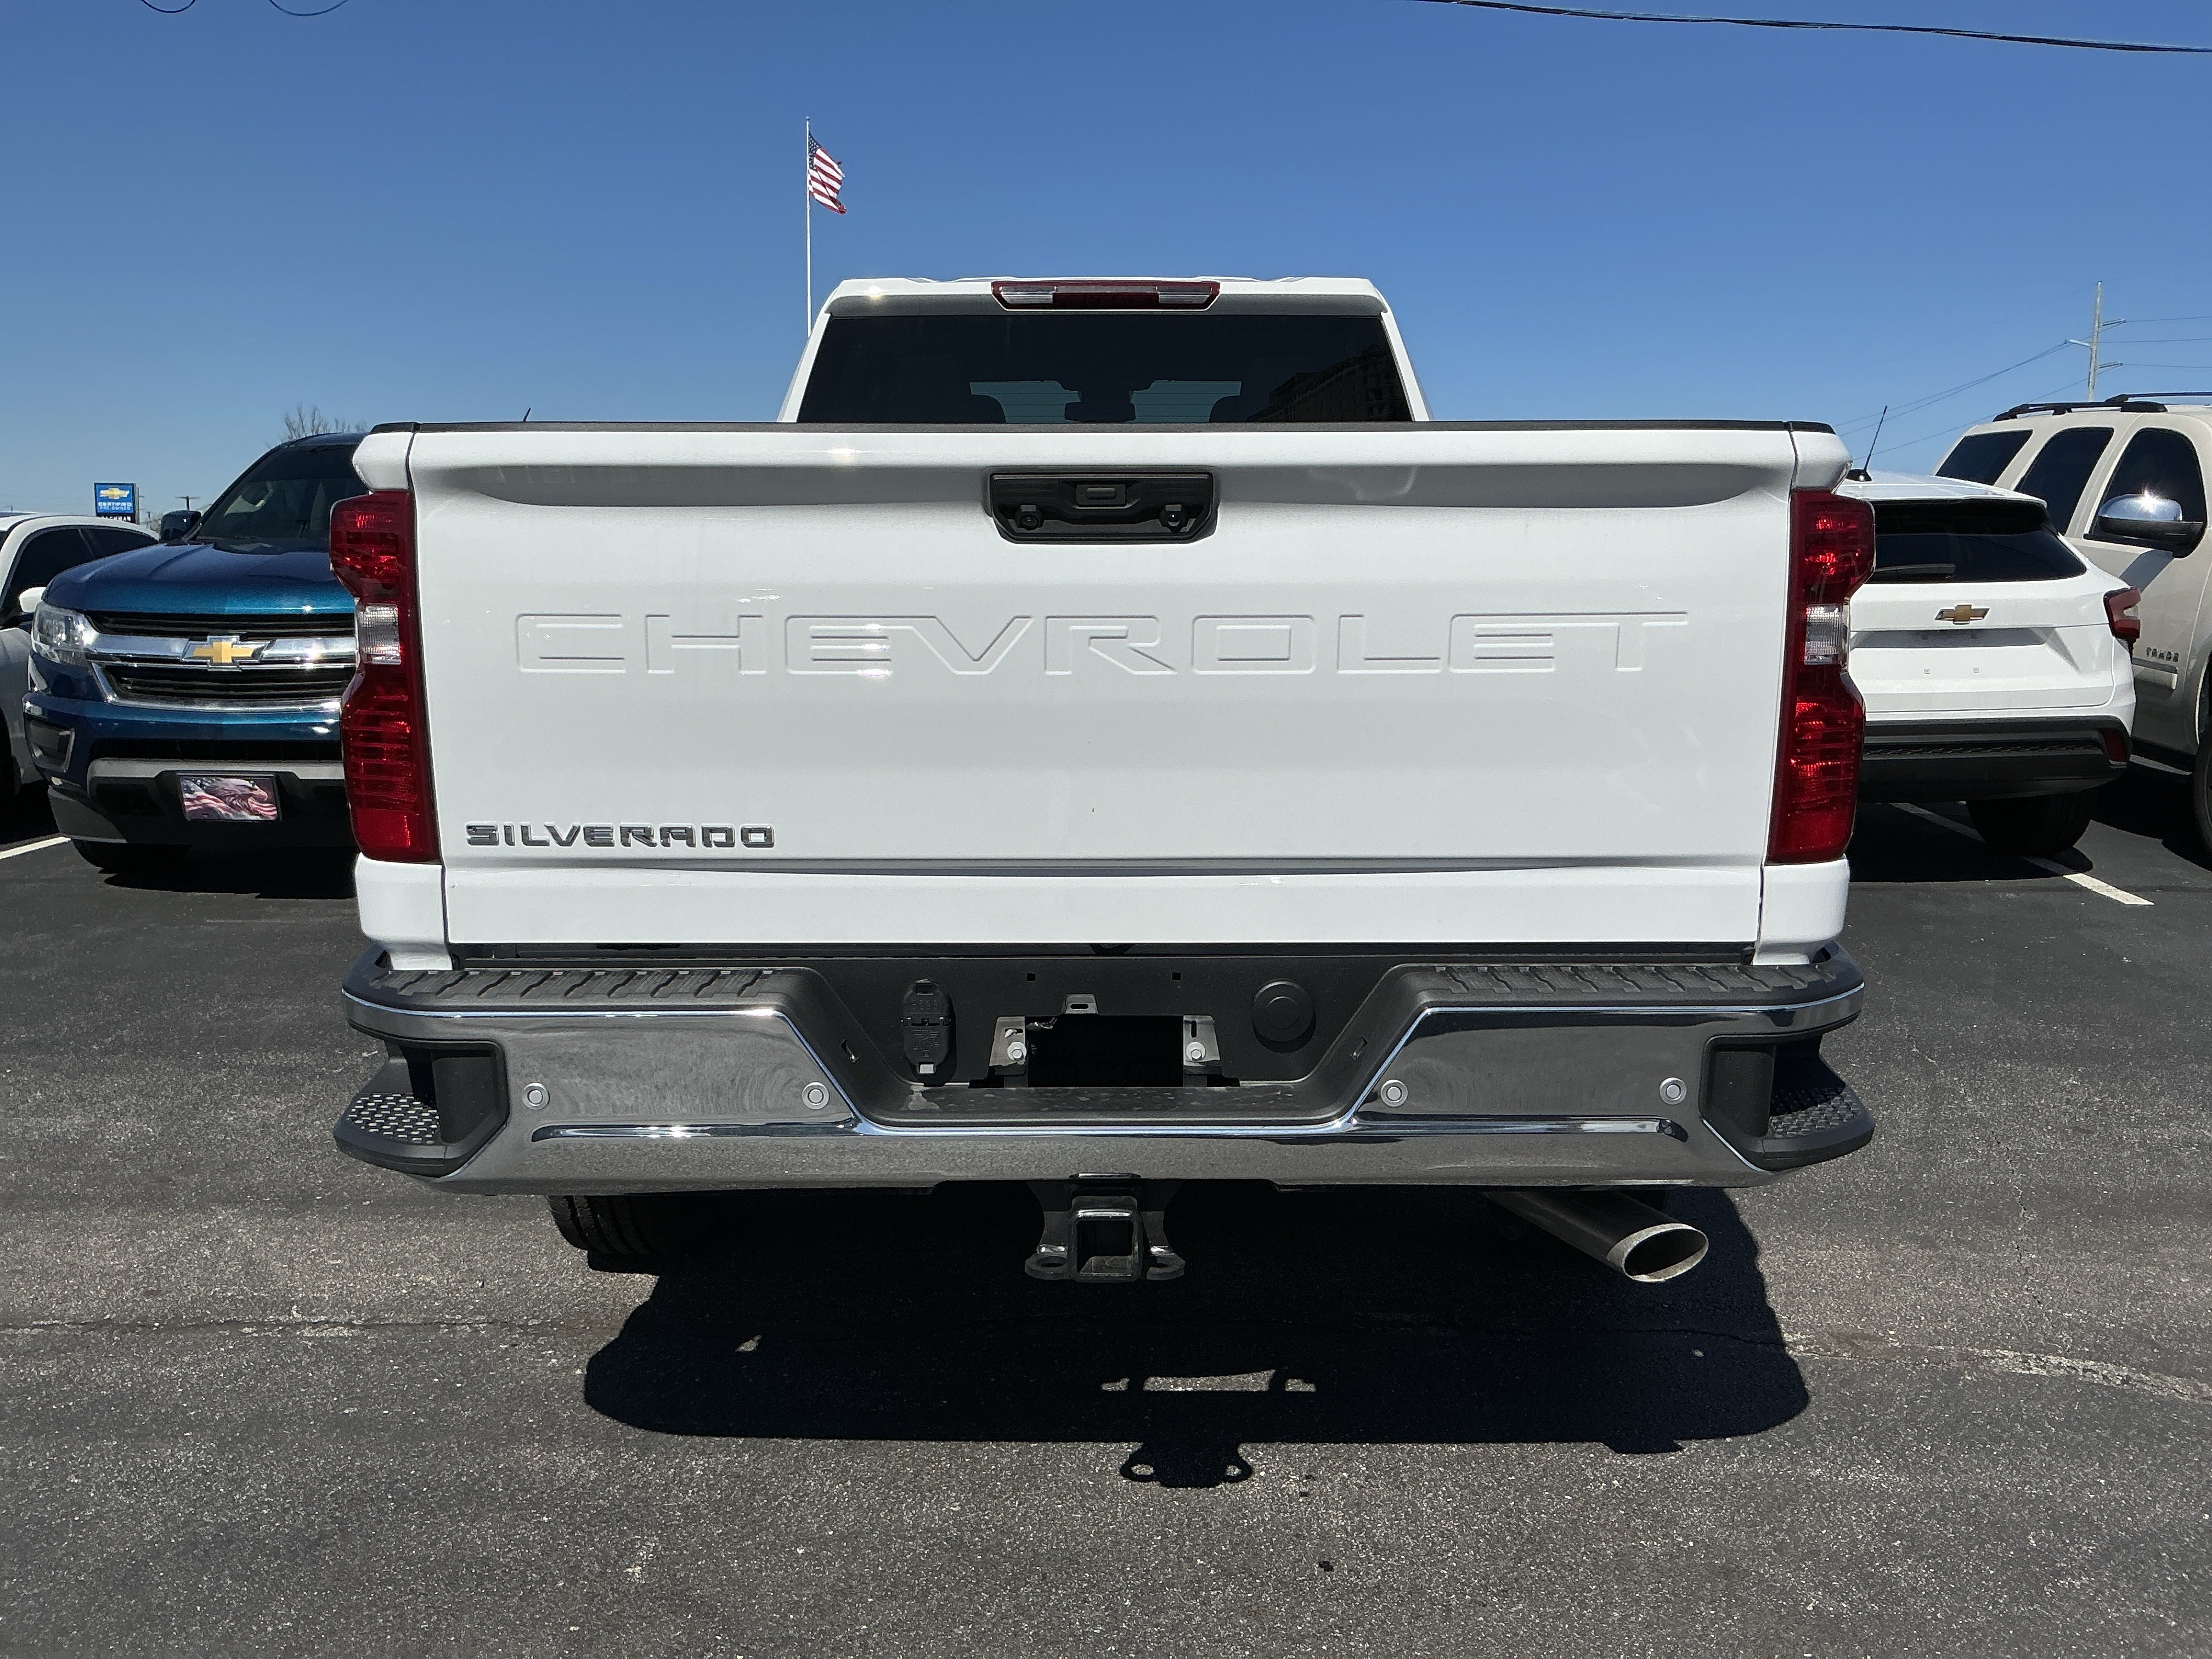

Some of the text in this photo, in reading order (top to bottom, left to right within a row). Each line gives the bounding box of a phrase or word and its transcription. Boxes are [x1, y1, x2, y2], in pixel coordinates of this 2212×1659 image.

[515, 612, 1689, 676] CHEVROLET
[2146, 647, 2180, 663] TAHOE
[466, 823, 775, 848] SILVERADO
